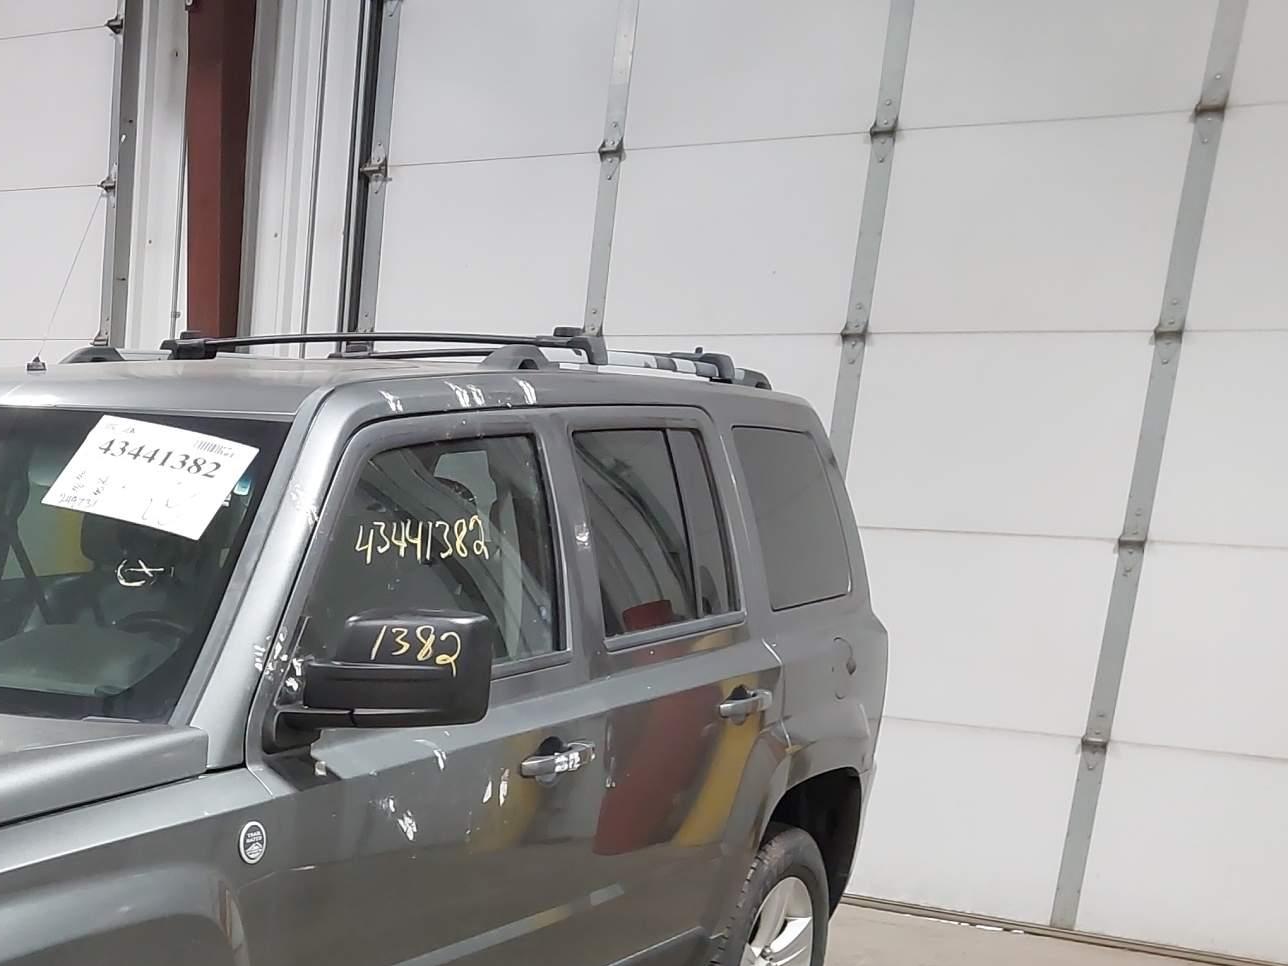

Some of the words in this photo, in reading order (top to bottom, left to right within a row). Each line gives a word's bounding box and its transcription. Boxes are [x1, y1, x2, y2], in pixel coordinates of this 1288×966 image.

[98, 438, 222, 479] 43441382
[355, 514, 489, 564] 43441382
[370, 625, 461, 678] 1382
